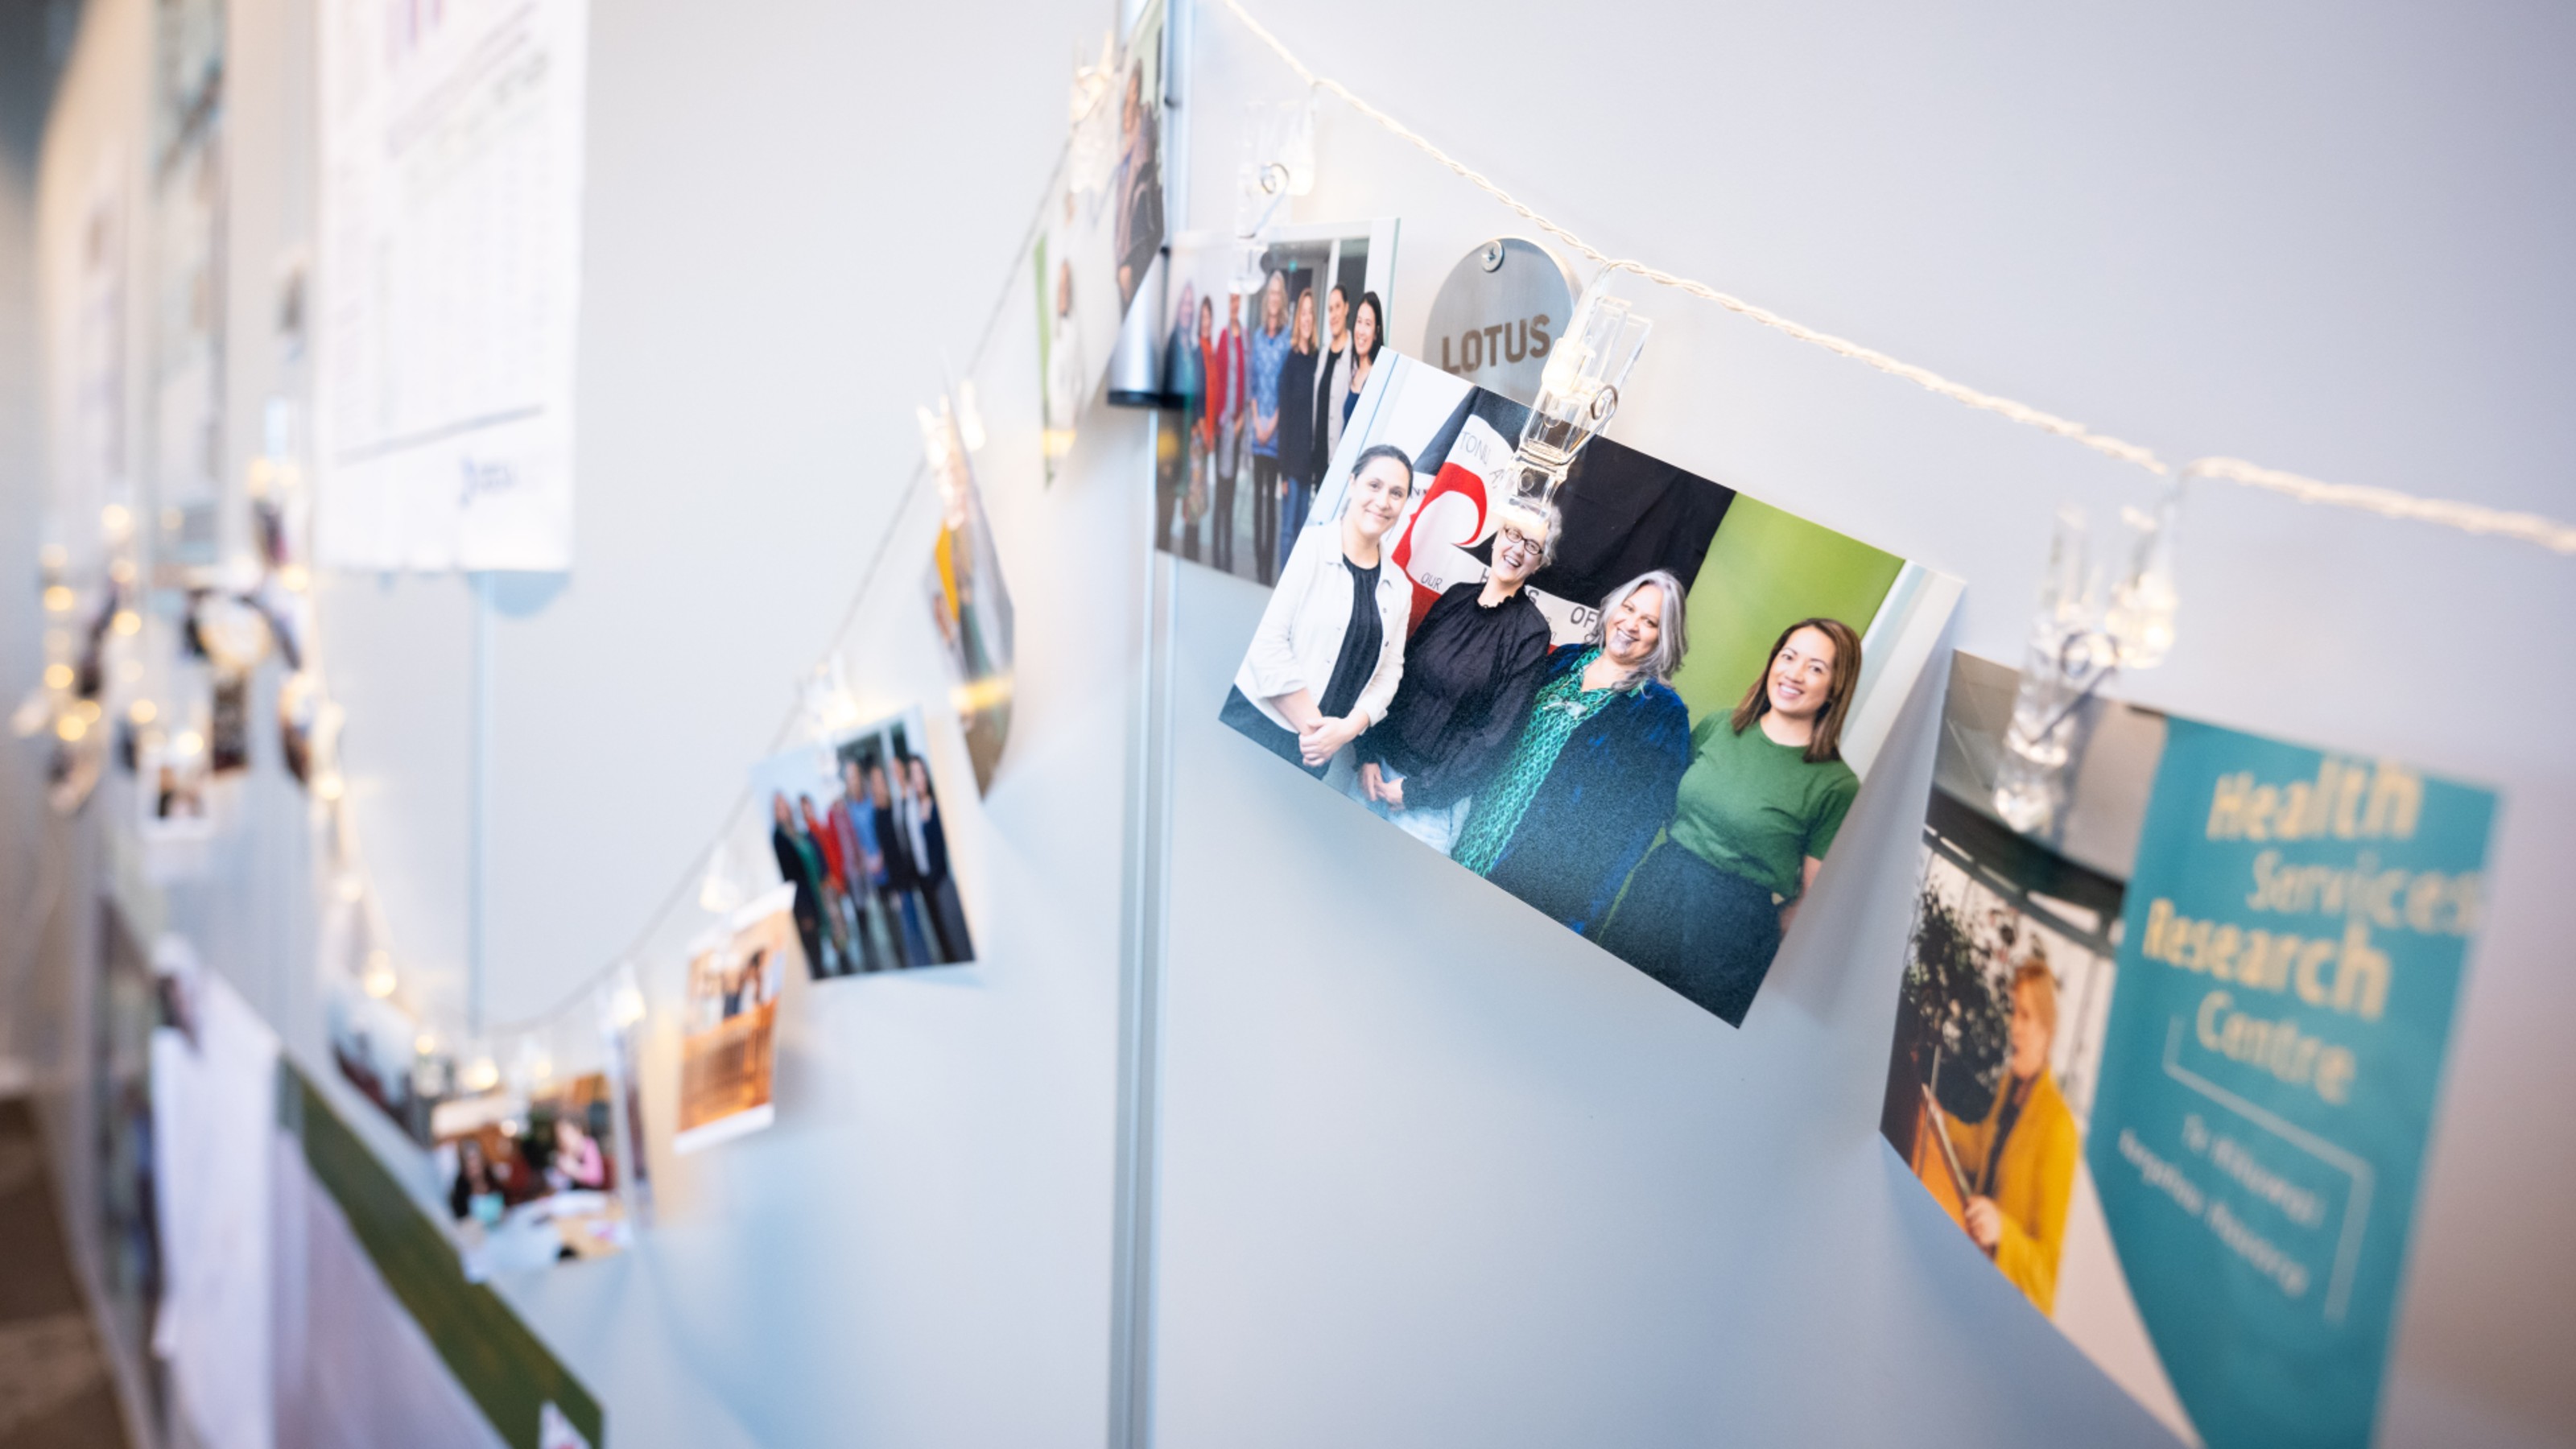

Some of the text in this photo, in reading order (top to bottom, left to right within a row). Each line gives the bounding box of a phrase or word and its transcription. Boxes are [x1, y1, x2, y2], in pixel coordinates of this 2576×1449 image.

[1442, 314, 1550, 374] LOTUS
[1421, 572, 1443, 591] OUR
[1571, 606, 1599, 628] OF
[2207, 758, 2423, 842] Health
[2247, 850, 2485, 935] Services
[2143, 898, 2392, 1022] Research
[2196, 990, 2356, 1104] Centre
